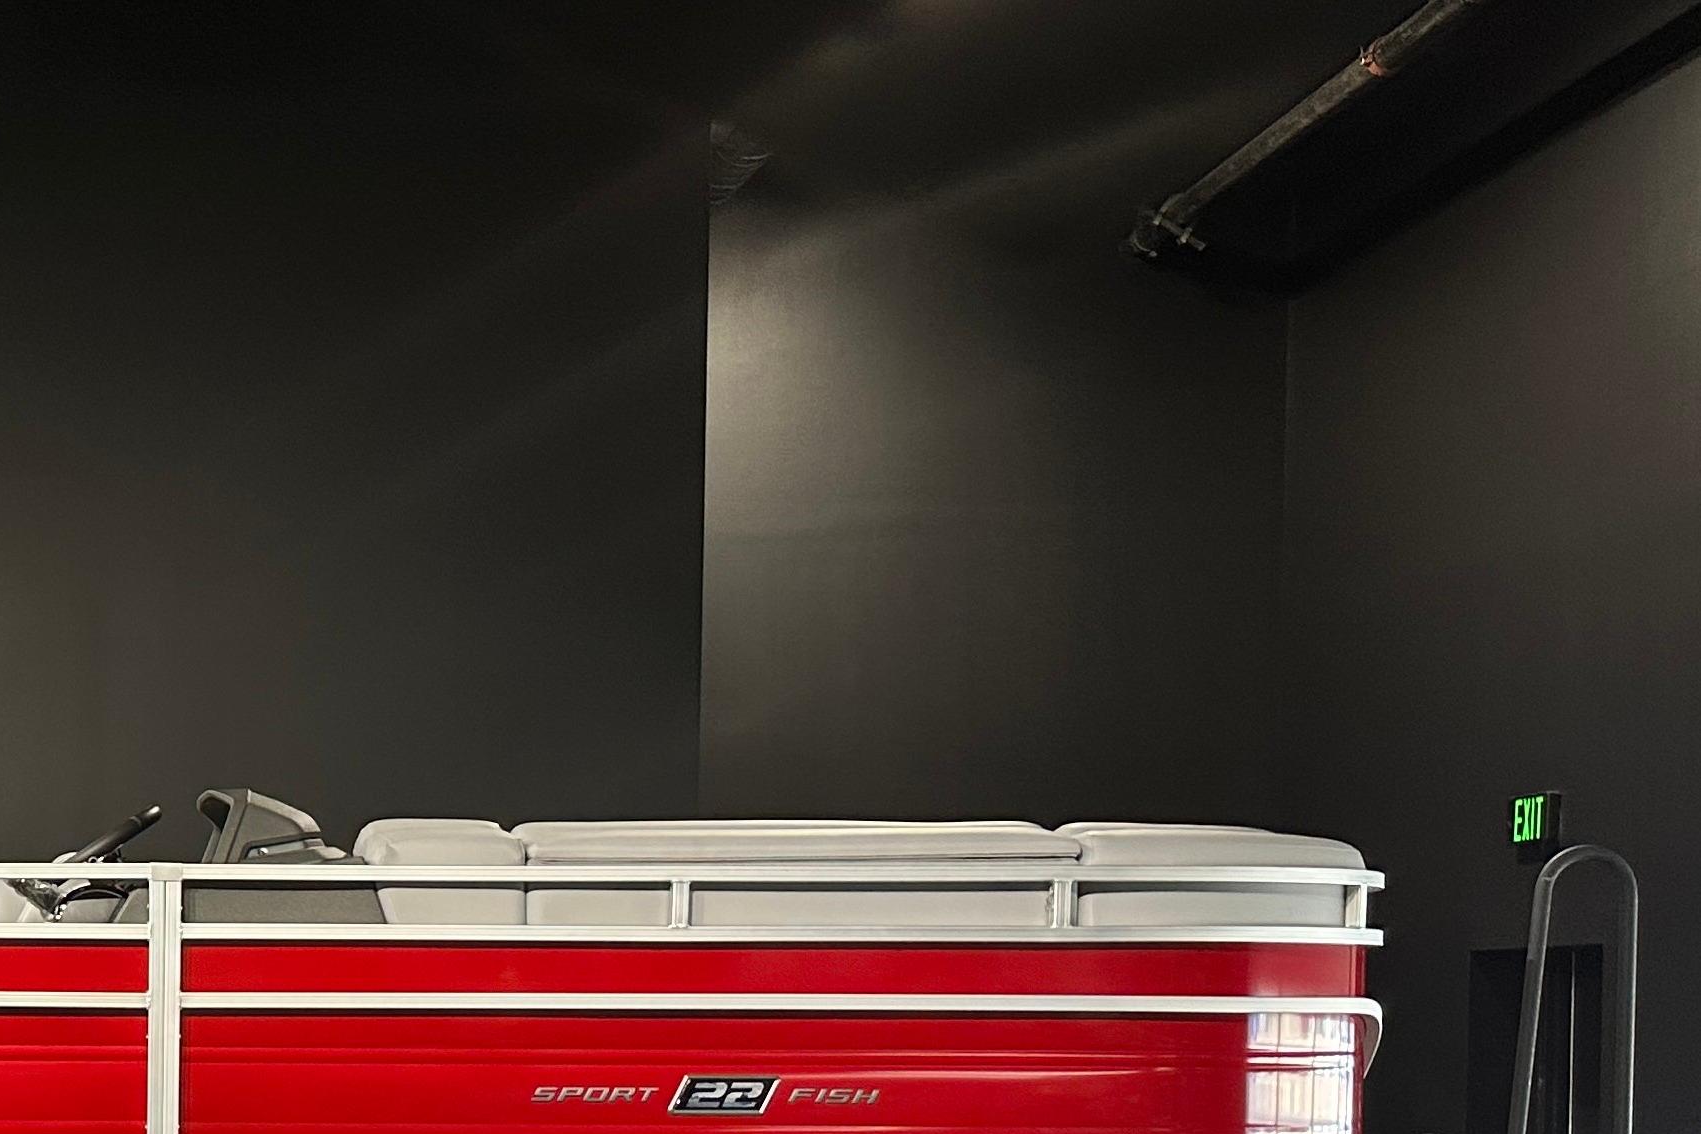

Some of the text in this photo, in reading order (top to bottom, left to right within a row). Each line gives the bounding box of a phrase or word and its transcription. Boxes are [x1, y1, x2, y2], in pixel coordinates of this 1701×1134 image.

[1513, 796, 1544, 842] EXIT
[530, 1082, 881, 1108] SPORT 22 FISH
